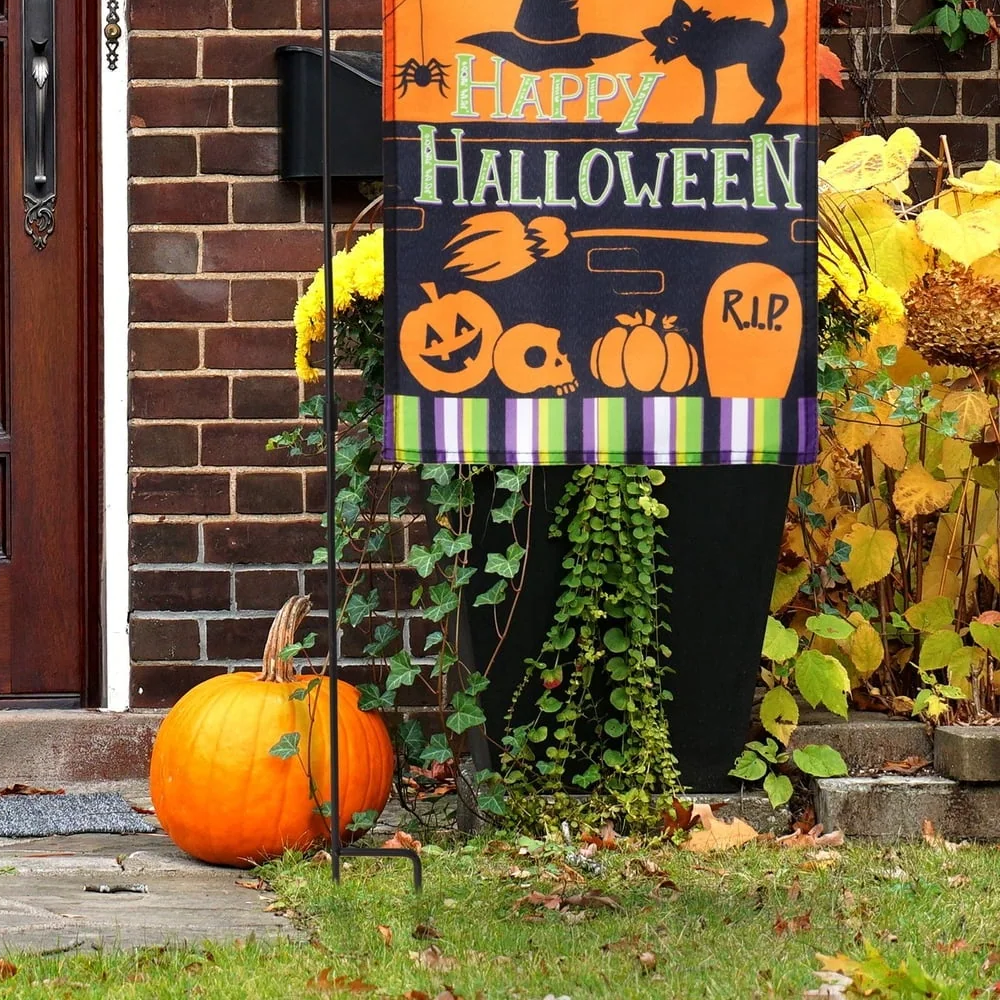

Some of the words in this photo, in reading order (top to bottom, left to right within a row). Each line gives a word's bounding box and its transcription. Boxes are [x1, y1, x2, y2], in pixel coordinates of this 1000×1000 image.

[451, 53, 666, 134] HAPPY
[414, 124, 802, 210] HALLOWEEN
[722, 289, 789, 331] R.I.P.
